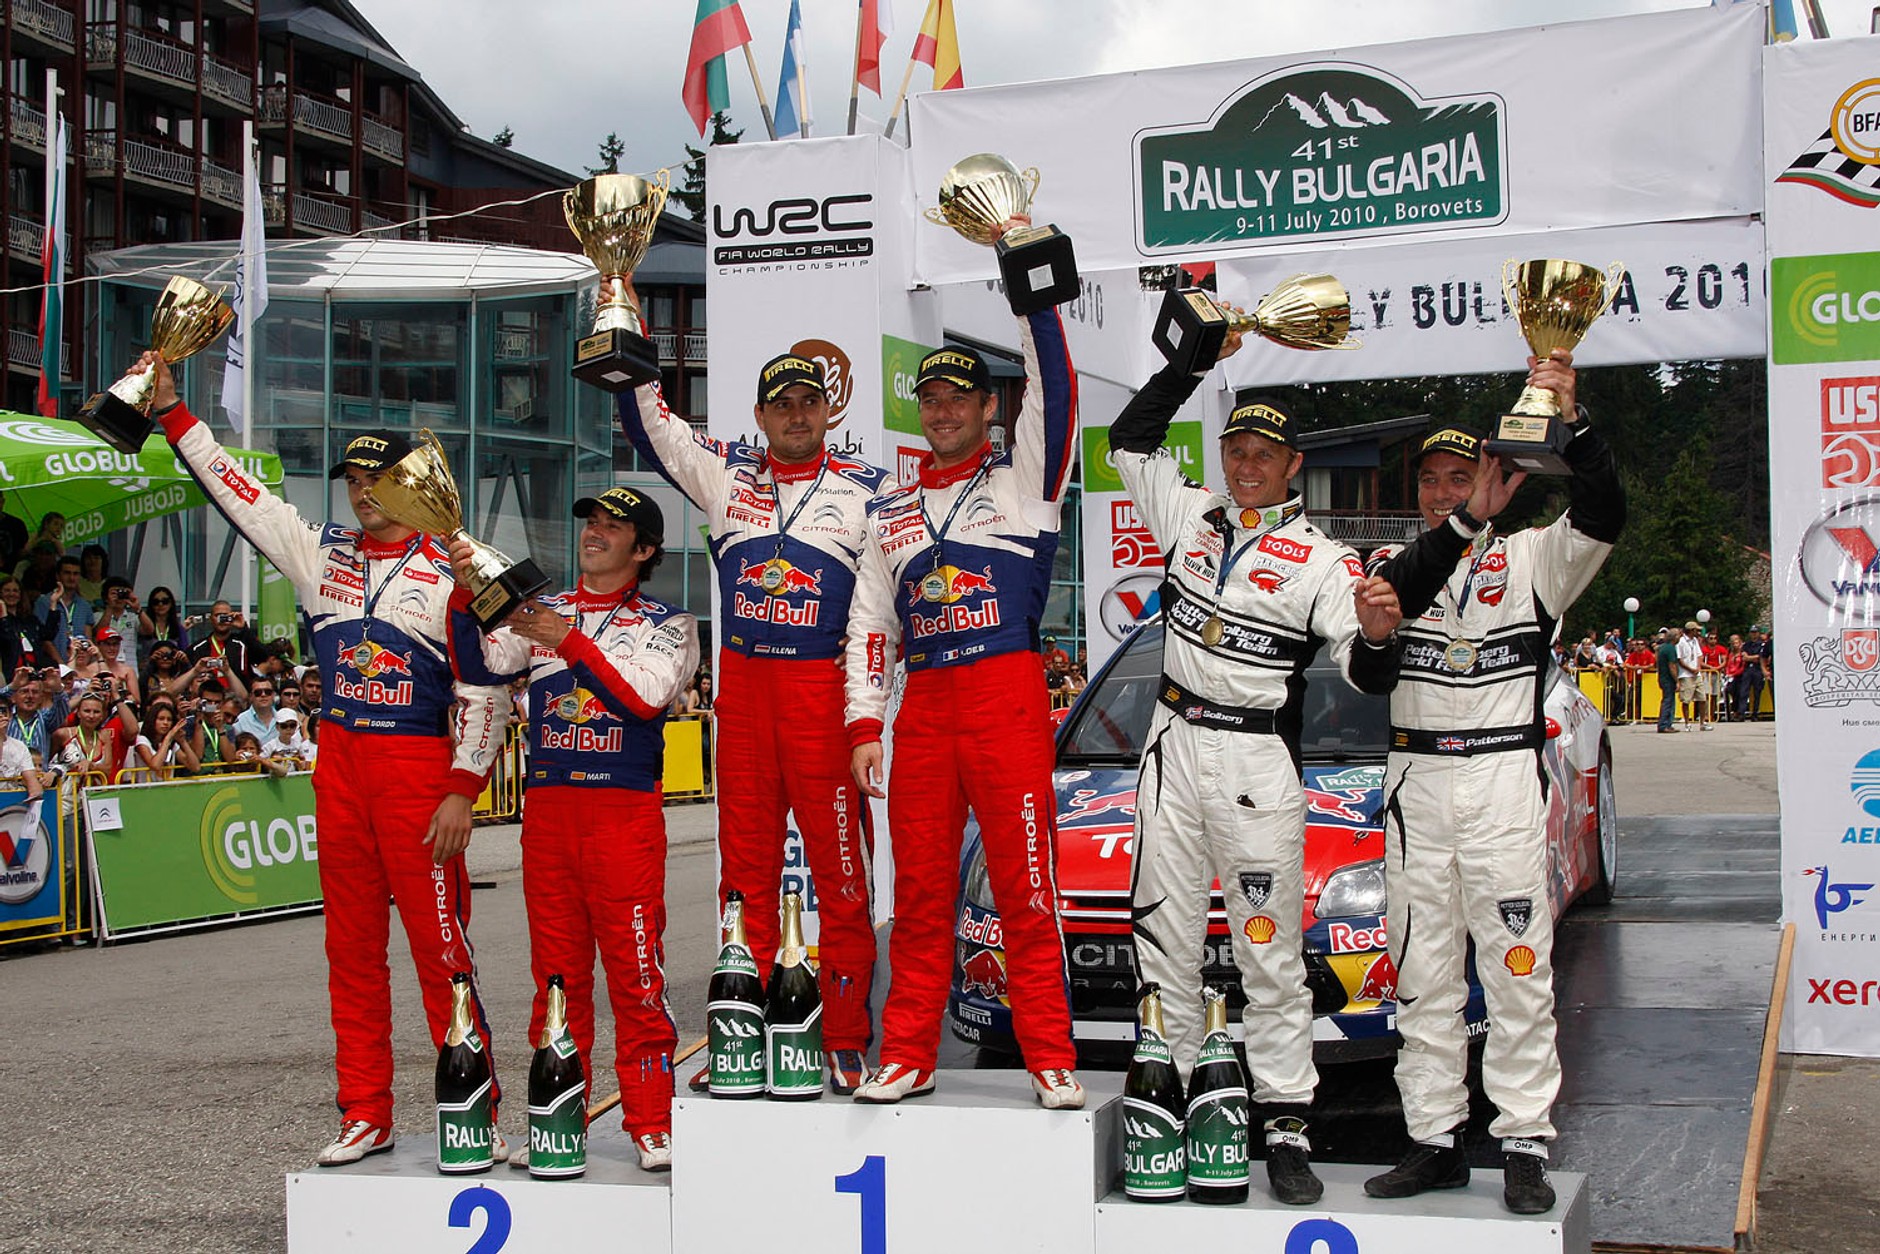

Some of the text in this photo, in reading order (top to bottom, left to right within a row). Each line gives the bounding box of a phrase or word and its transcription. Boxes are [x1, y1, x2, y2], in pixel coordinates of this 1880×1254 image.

[1291, 134, 1359, 161] 41st
[1163, 131, 1486, 212] RALLY BULGARIA
[714, 194, 874, 239] WRC
[1236, 216, 1277, 236] 9-11
[1284, 210, 1323, 233] July
[1329, 204, 1377, 226] 2010
[1395, 196, 1484, 221] Borovets
[718, 243, 869, 260] FIA WORLD RALLY
[719, 259, 869, 276] CHAMPIONSHIP
[1664, 262, 1766, 312] 201
[921, 350, 976, 372] PIRELLI
[1231, 404, 1287, 428] PIRELLI
[45, 453, 145, 479] GLOBUL
[226, 473, 256, 500] TOTAL
[741, 491, 773, 510] TOTAL
[726, 506, 771, 528] PIRELLI
[891, 517, 923, 531] TOTAL
[802, 526, 850, 536] CITROËN
[1265, 539, 1306, 558] TOOLS
[321, 584, 363, 608] PIRELLI
[734, 591, 820, 627] Red Bull
[910, 598, 1001, 639] Red Bull
[771, 646, 797, 656] ELENA
[870, 634, 882, 671] TOTAL
[1236, 636, 1279, 655] Team
[1479, 654, 1520, 669] Team
[335, 672, 413, 705] Red Bull
[1203, 710, 1243, 724] Solberg
[541, 724, 623, 752] Red Bull
[1466, 733, 1523, 747] Patterson
[586, 772, 611, 780] MARTI
[833, 785, 854, 877] CITROËN
[1021, 793, 1042, 888] CITROËN
[960, 907, 989, 943] Red
[631, 904, 652, 990] CITROËN
[1807, 978, 1880, 1006] xer
[959, 1002, 991, 1025] PIRELLI
[724, 1041, 743, 1052] 41st
[717, 1051, 764, 1073] BULG
[531, 1126, 580, 1154] RALLY
[1282, 1135, 1299, 1143] OMP
[1514, 1141, 1534, 1150] OMP
[835, 1155, 886, 1254] 1
[448, 1187, 512, 1254] 2
